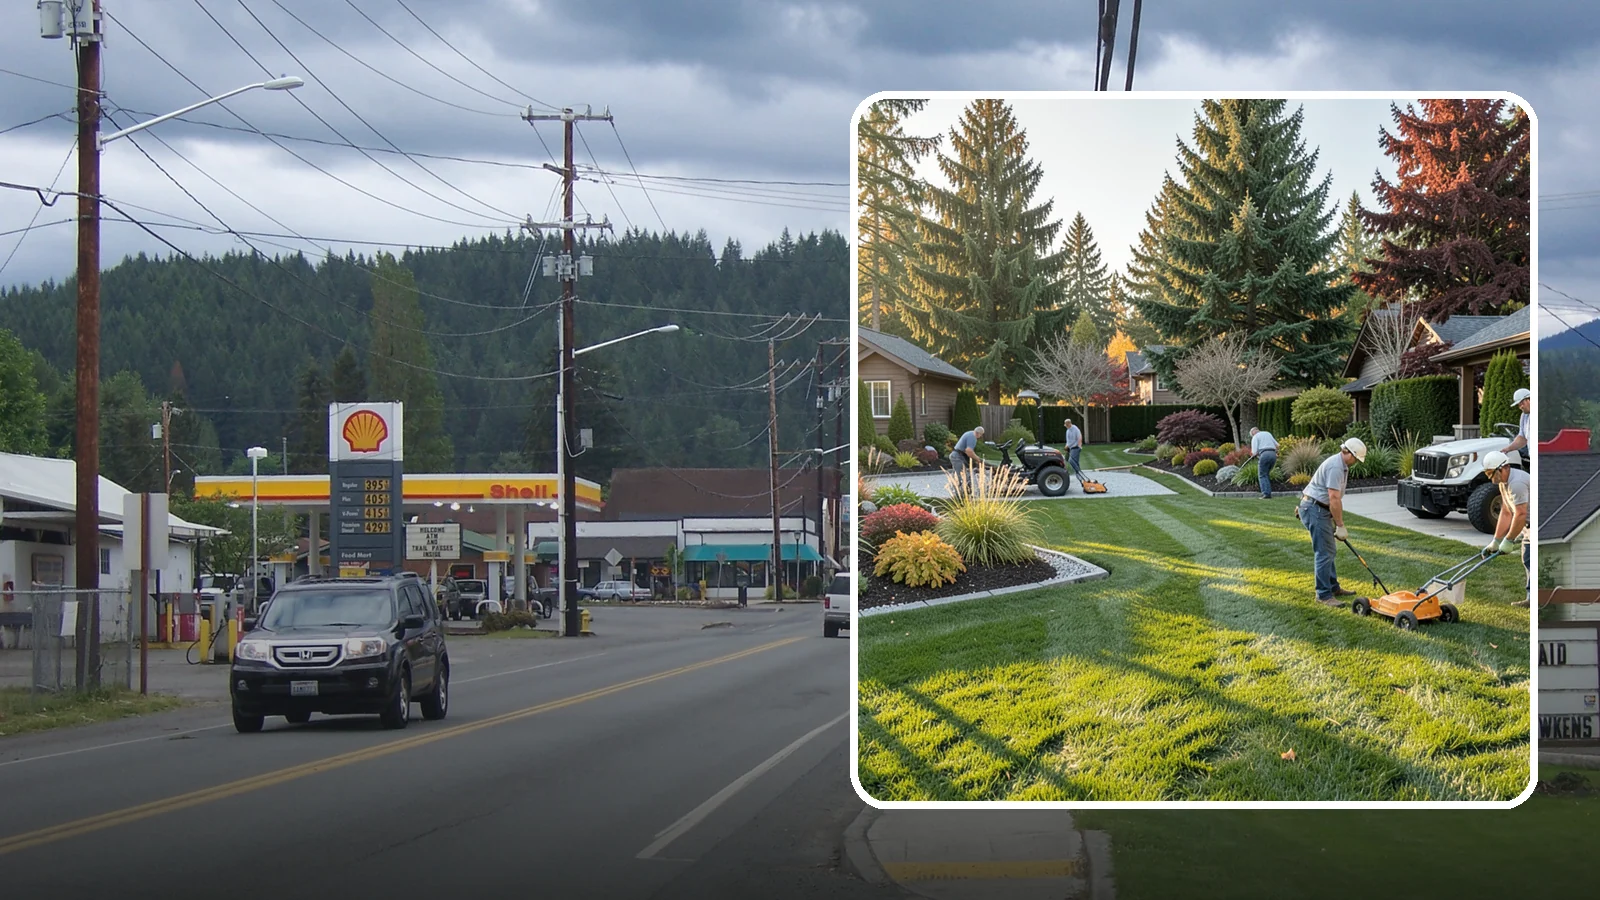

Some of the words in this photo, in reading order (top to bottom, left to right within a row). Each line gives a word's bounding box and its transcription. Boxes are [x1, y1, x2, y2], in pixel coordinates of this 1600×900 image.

[366, 480, 383, 490] 395
[490, 484, 547, 499] Shell
[366, 494, 383, 504] 405
[366, 508, 383, 518] 415
[366, 522, 383, 532] 429
[1538, 643, 1567, 665] AID
